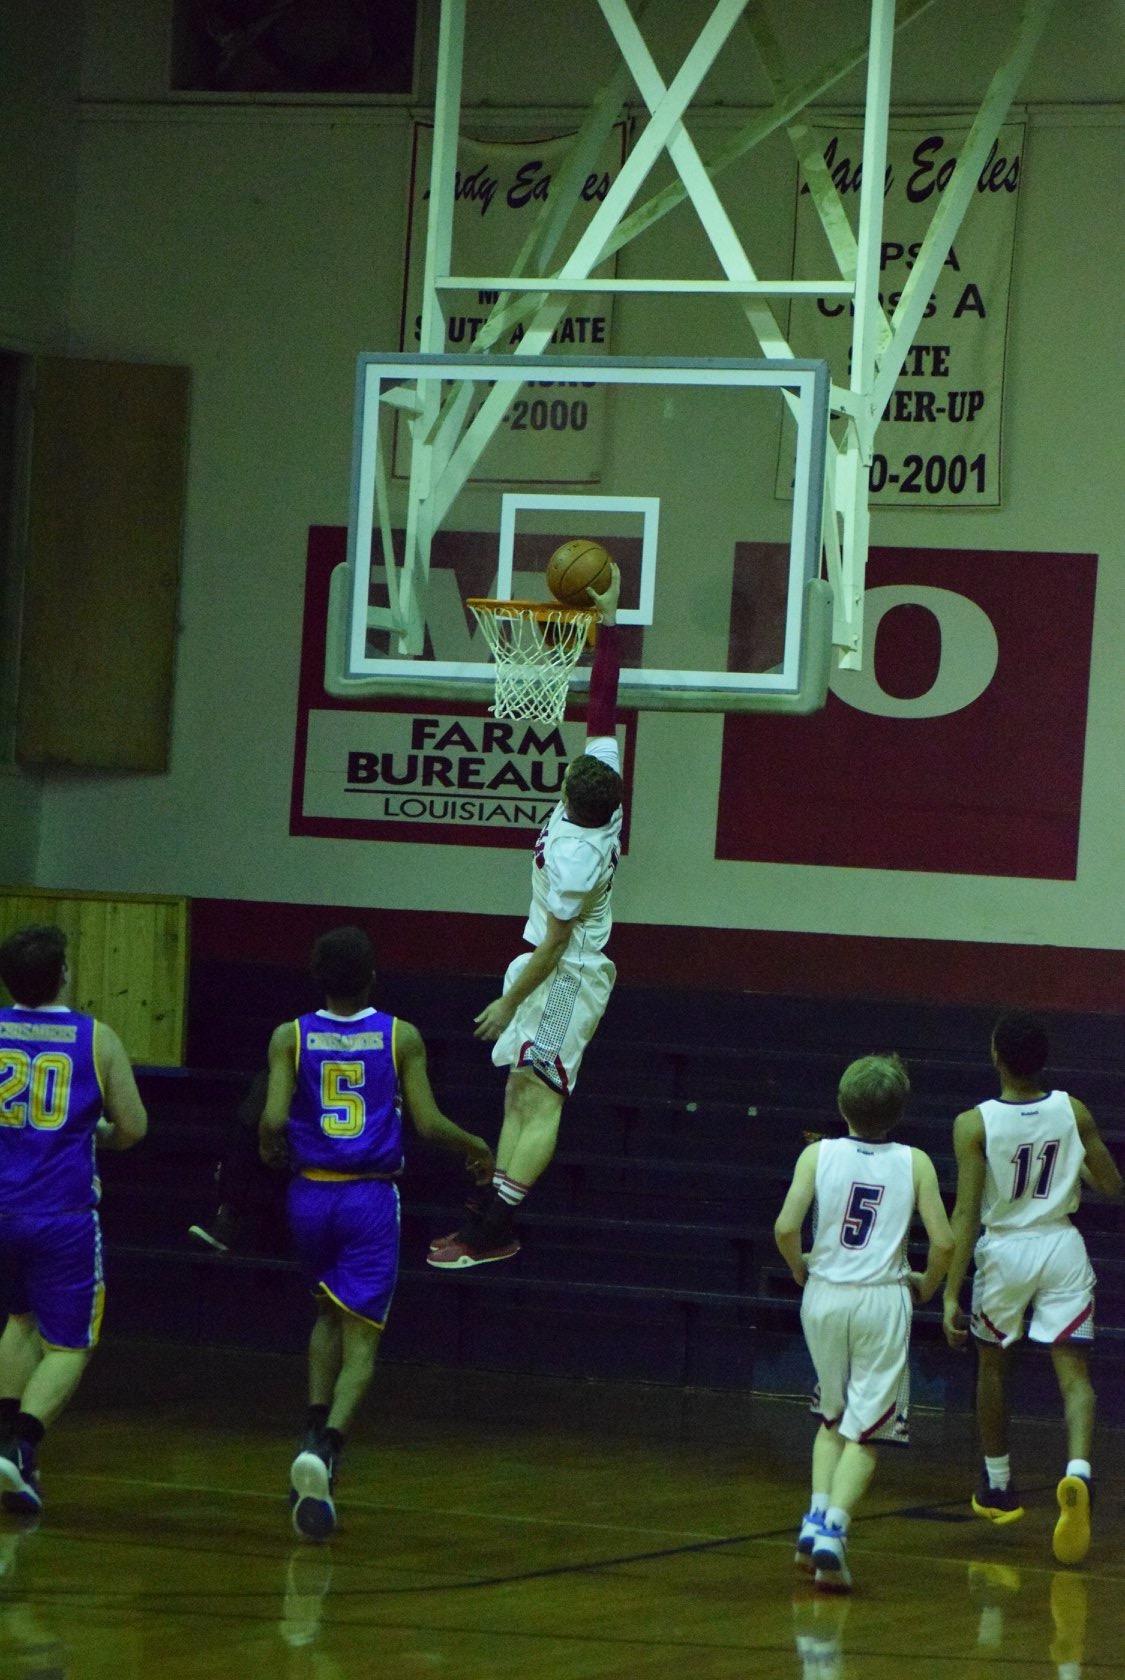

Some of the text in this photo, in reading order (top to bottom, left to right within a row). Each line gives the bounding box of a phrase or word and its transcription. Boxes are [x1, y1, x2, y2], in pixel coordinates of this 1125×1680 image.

[508, 161, 610, 208] Eaes
[907, 136, 1020, 203] Eales
[953, 284, 986, 318] A
[411, 719, 567, 757] FARM
[347, 752, 568, 793] BUREAU
[0, 1048, 73, 1131] 20
[320, 1060, 365, 1138] 5
[1010, 1139, 1060, 1203] 11
[840, 1181, 885, 1251] 5
